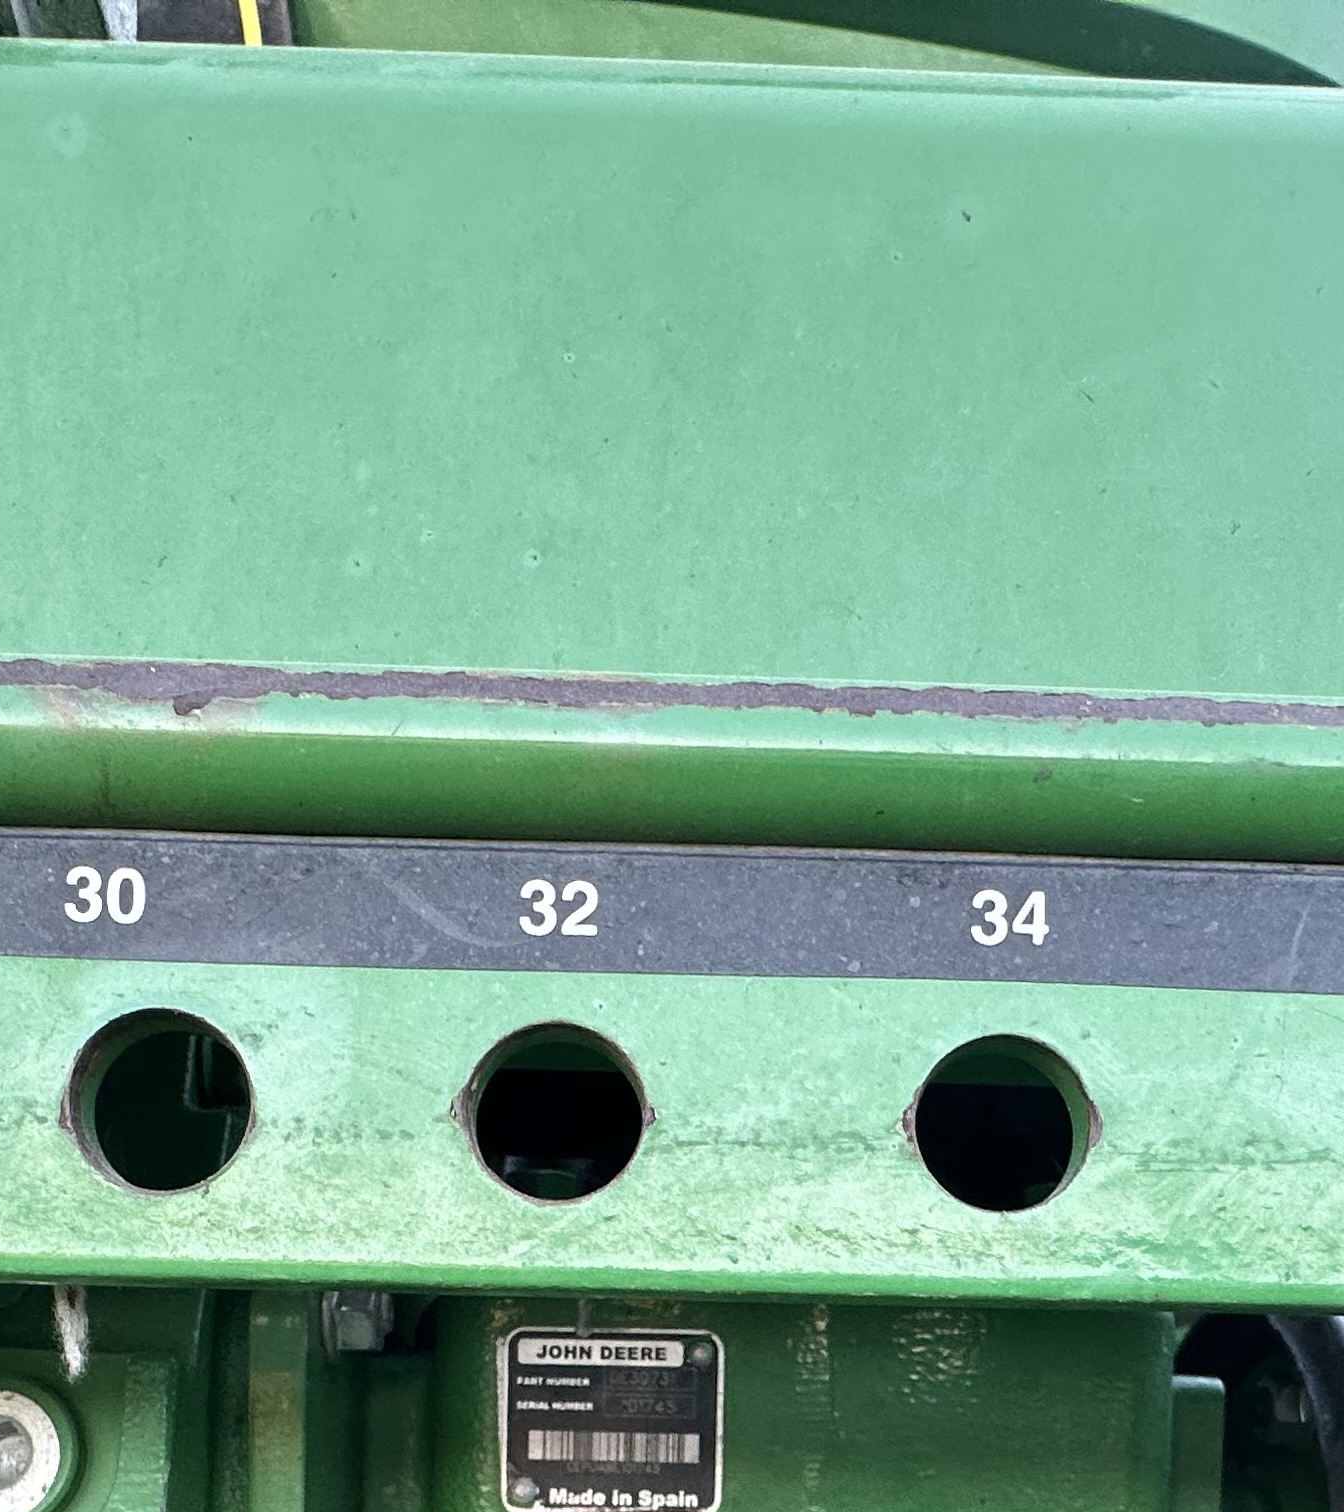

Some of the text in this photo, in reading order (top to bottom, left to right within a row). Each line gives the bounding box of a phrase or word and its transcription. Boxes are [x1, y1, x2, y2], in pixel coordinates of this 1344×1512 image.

[64, 866, 147, 925] 30
[518, 879, 599, 937] 32
[970, 889, 1050, 946] 34
[536, 1344, 668, 1361] JOHN DEERE
[516, 1376, 591, 1388] PART NUMBER
[516, 1400, 594, 1412] SERIAL NUMBER
[549, 1488, 699, 1511] Made in Spain
